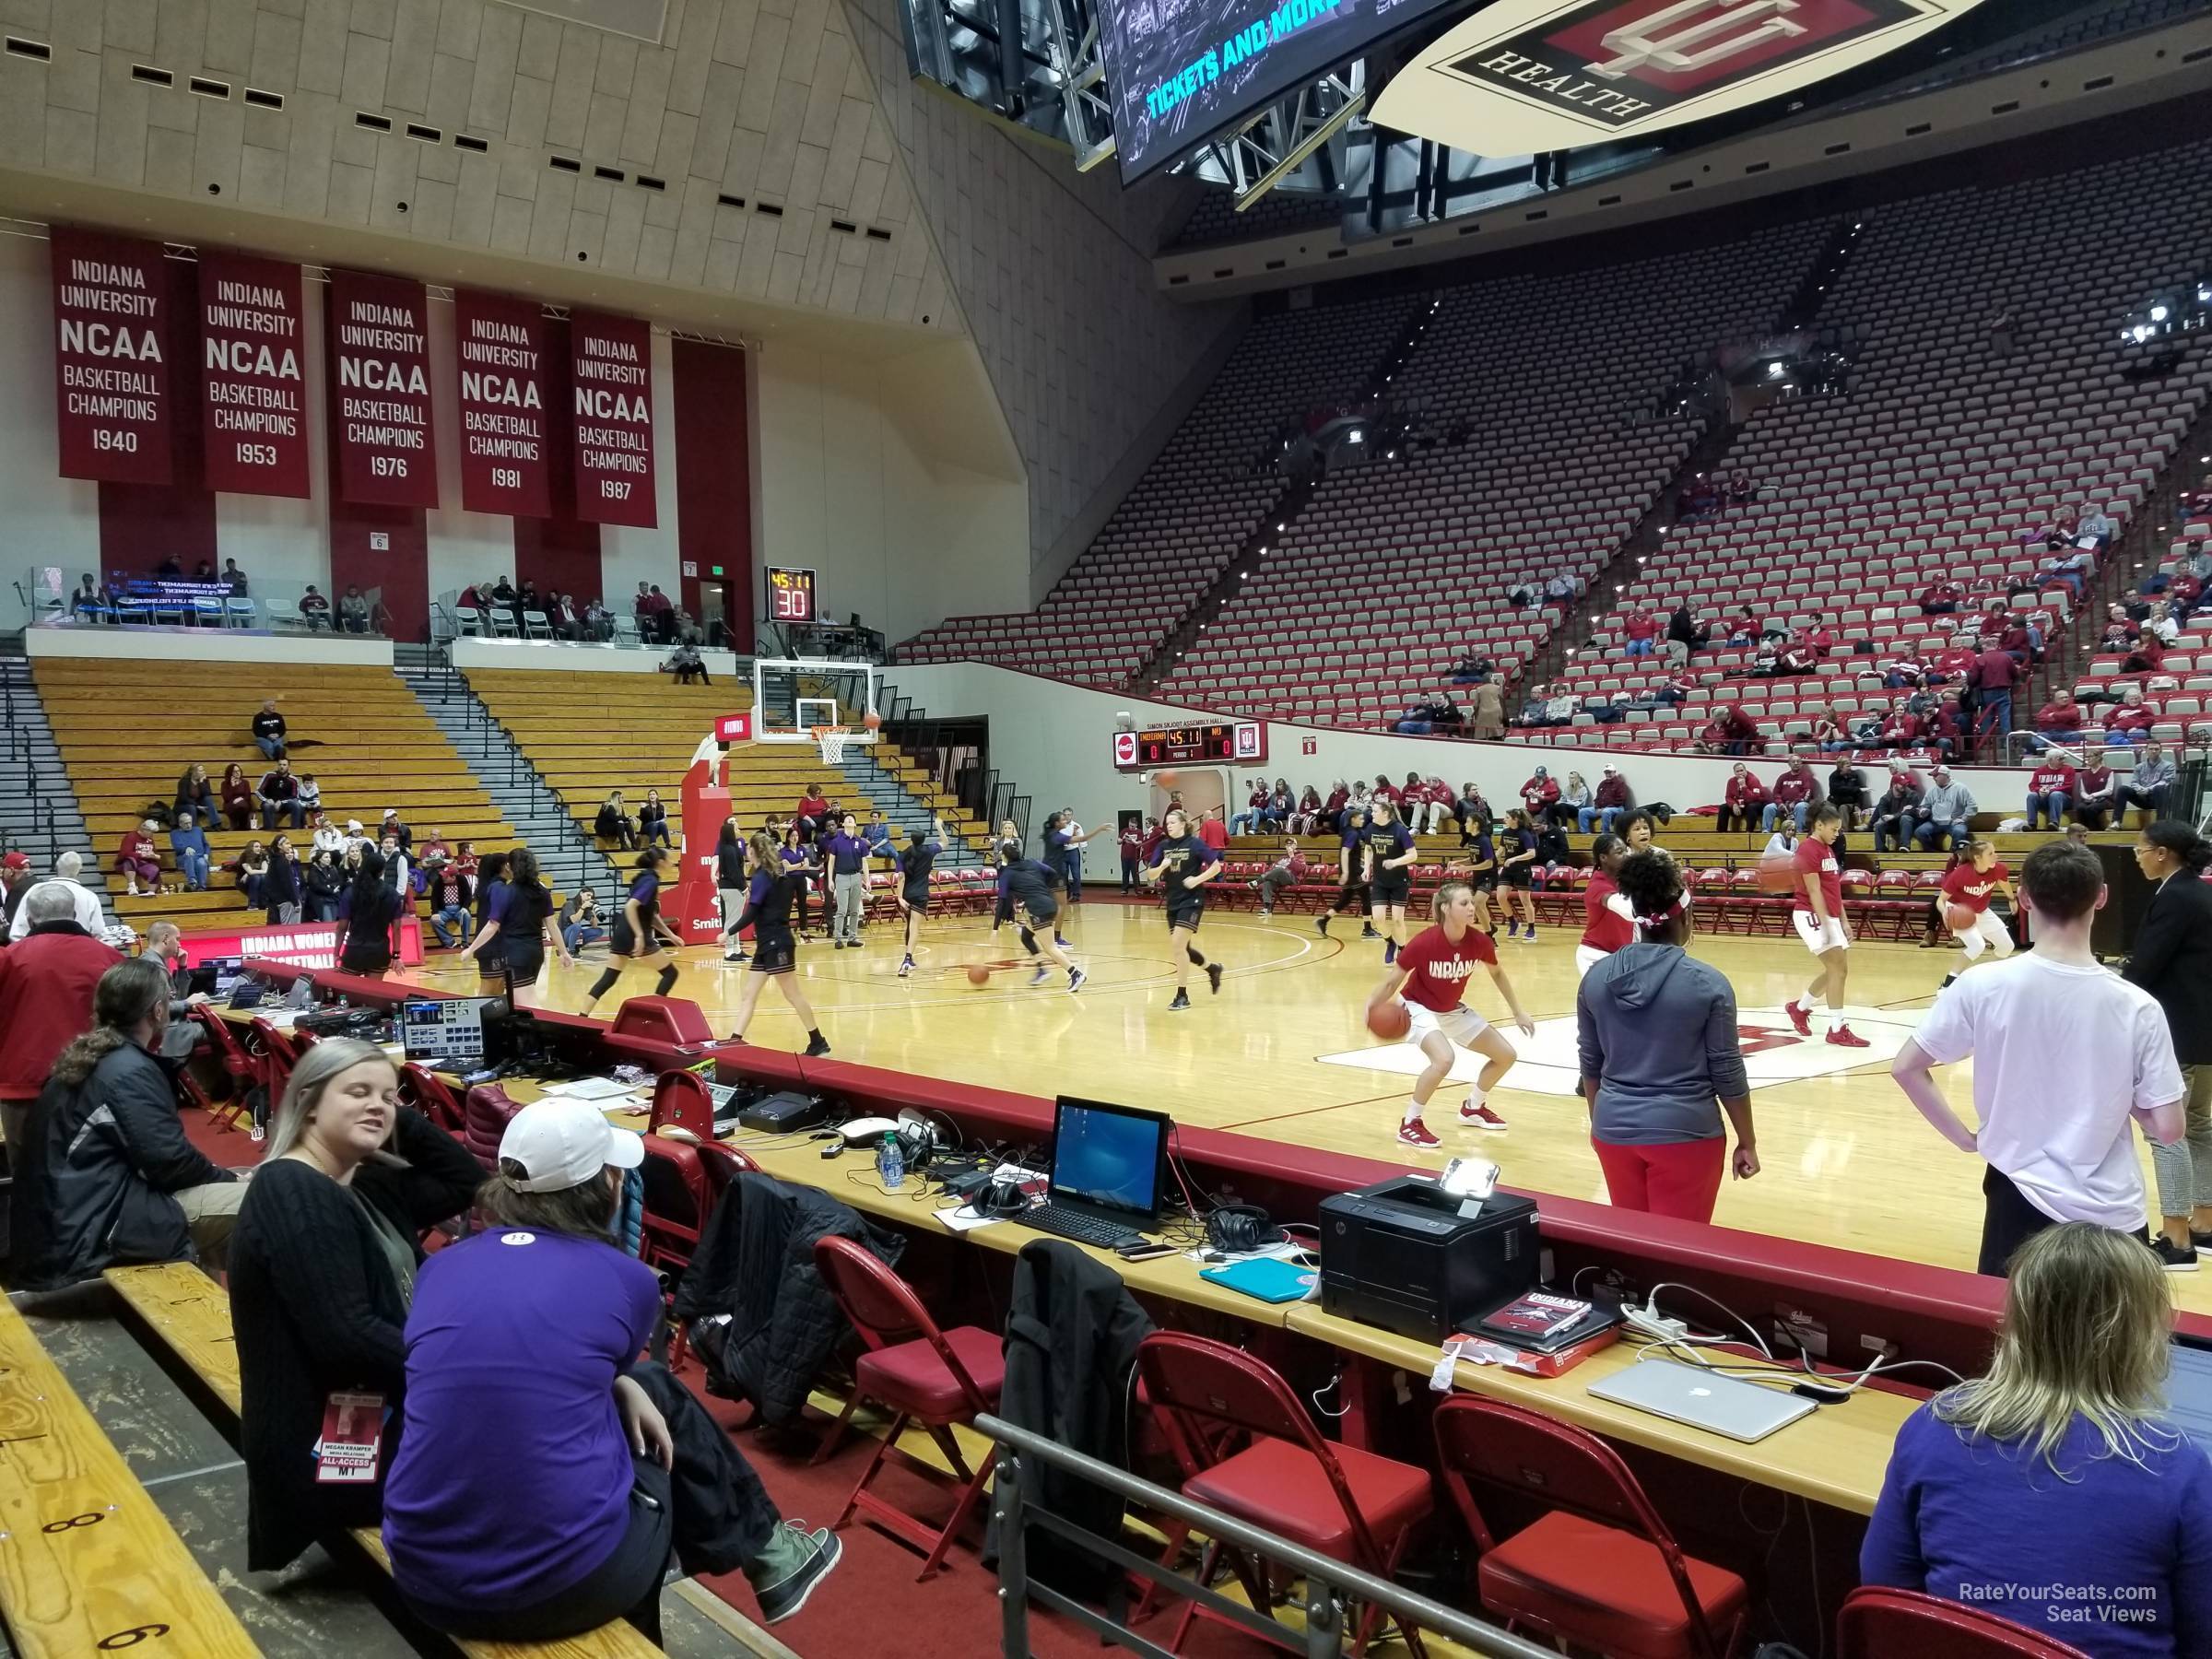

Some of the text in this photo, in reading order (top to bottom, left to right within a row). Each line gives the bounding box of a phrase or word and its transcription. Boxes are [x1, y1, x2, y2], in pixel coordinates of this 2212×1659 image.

[1147, 52, 1218, 118] TICKETS
[1223, 20, 1268, 71] AND
[1478, 51, 1652, 117] HEALTH
[72, 259, 146, 288] INDIANA
[61, 285, 157, 317] UNIVERSITY
[218, 280, 285, 310] INDIANA
[207, 305, 295, 337] UNIVERSITY
[351, 300, 414, 328] INDIANA
[61, 319, 162, 362] NCAA
[341, 324, 424, 354] UNIVERSITY
[472, 318, 529, 346] INDIANA
[206, 337, 300, 381] NCAA
[463, 341, 537, 371] UNIVERSITY
[584, 337, 638, 362] INDIANA
[64, 365, 160, 395] BASKETBALL
[340, 356, 428, 395] NCAA
[577, 359, 646, 385] UNIVERSITY
[209, 382, 300, 411] BASKETBALL
[462, 371, 542, 409] NCAA
[68, 393, 157, 421] CHAMPIONS
[344, 397, 427, 425] BASKETBALL
[575, 387, 650, 424] NCAA
[215, 409, 296, 436] CHAMPIONS
[465, 411, 541, 438] BASKETBALL
[93, 429, 137, 453] 1940
[347, 423, 424, 449] CHAMPIONS
[469, 436, 538, 461] CHAMPIONS
[579, 426, 649, 452] BASKETBALL
[236, 442, 276, 465] 1953
[371, 456, 407, 477] 1976
[582, 450, 647, 474] CHAMPIONS
[492, 467, 521, 488] 1981
[601, 480, 631, 500] 1987
[377, 538, 383, 547] 6
[772, 574, 810, 589] 45:11
[778, 590, 806, 617] 30
[1183, 718, 1209, 726] ASSEMBLY
[1170, 729, 1199, 745] 45:11
[1223, 740, 1230, 754] 0
[1307, 742, 1312, 752] 8
[1150, 745, 1157, 759] 0
[241, 935, 294, 954] INDIANA
[1528, 1292, 1584, 1309] INDIANA
[323, 1457, 370, 1466] ALL-ACCESS
[42, 1512, 105, 1534] 8
